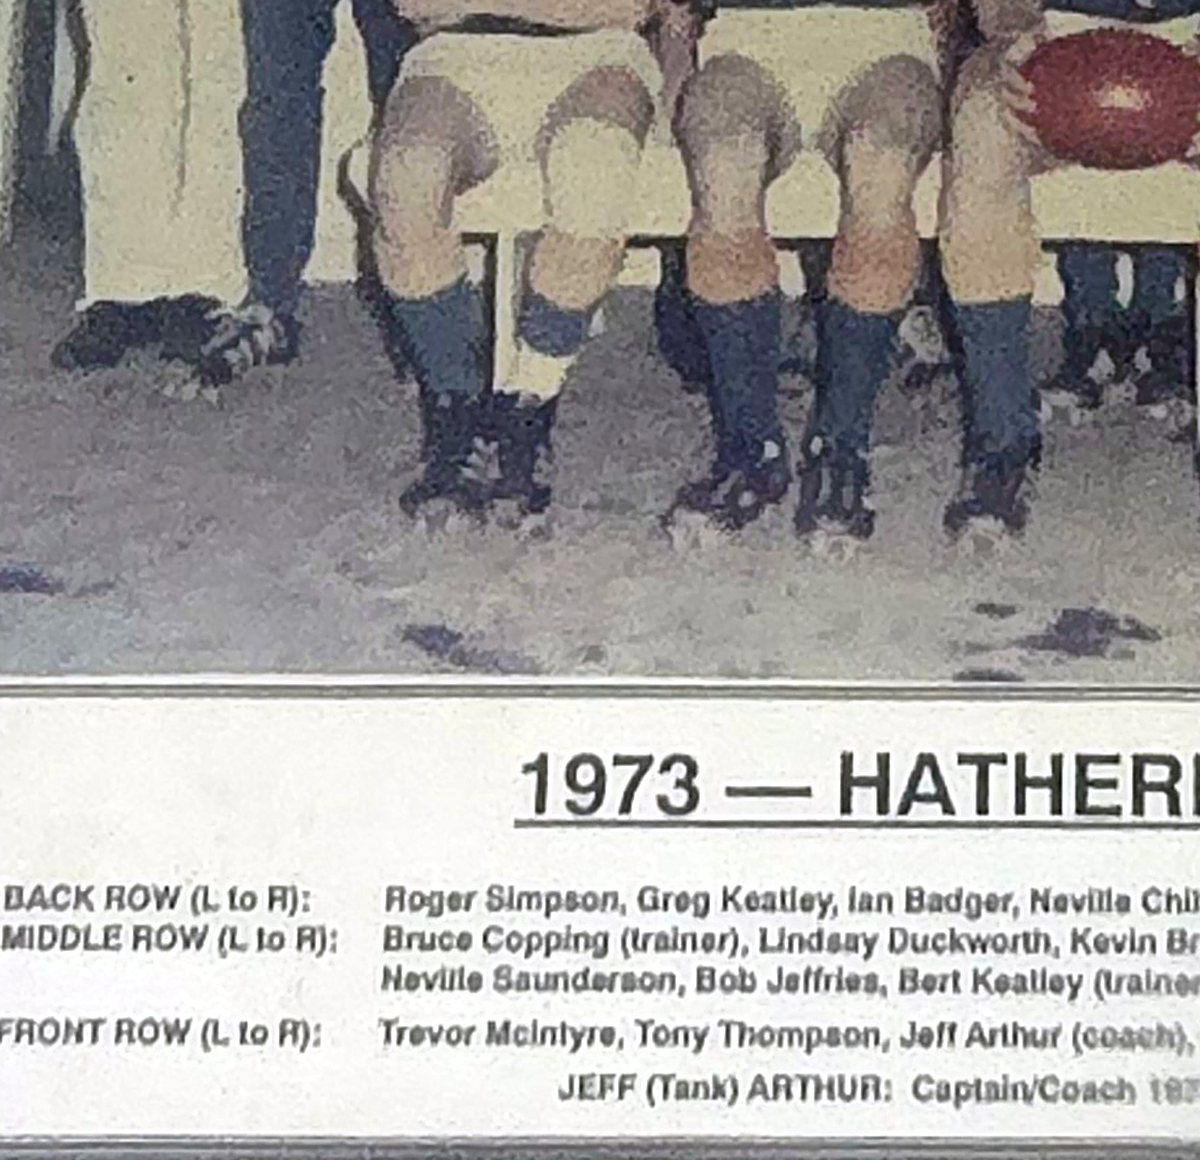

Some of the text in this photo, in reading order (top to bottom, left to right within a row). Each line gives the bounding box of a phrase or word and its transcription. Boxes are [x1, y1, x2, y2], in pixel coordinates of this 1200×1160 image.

[522, 753, 701, 818] 1973
[4, 884, 96, 913] BACK
[105, 884, 184, 913] ROW
[188, 885, 222, 917] (L
[228, 886, 258, 913] to
[269, 885, 312, 917] R):
[386, 886, 479, 919] Roger
[486, 885, 628, 921] Simpson,
[638, 886, 711, 921] Greg
[722, 886, 839, 922] Keatley,
[849, 886, 895, 917] Ian
[905, 887, 1021, 923] Badger,
[1031, 887, 1132, 918] Neville
[1, 924, 123, 953] MIDDLE
[133, 925, 210, 954] ROW
[219, 925, 250, 956] (L
[257, 927, 287, 954] to
[296, 925, 339, 956] R):
[384, 925, 474, 954] Bruce
[483, 925, 611, 961] Copping
[622, 926, 750, 962] (trainer),
[760, 927, 881, 963] Lindsay
[889, 928, 1061, 961] Duckworth,
[1071, 927, 1158, 958] Kevin
[382, 967, 484, 994] Neville
[494, 967, 687, 999] Saunderson,
[696, 966, 758, 996] Bob
[767, 966, 889, 1000] Jeffries,
[899, 967, 962, 997] Bert
[972, 968, 1084, 1002] Keatley
[0, 1018, 108, 1048] FRONT
[115, 1017, 193, 1048] ROW
[202, 1019, 231, 1052] (L
[240, 1022, 270, 1047] to
[280, 1019, 322, 1051] R):
[378, 1018, 478, 1051] Trevor
[486, 1020, 625, 1055] McIntyre,
[635, 1019, 711, 1056] Tony
[718, 1020, 891, 1057] Thompson,
[900, 1022, 957, 1051] Jeff
[965, 1022, 1063, 1052] Arthur
[1073, 1022, 1197, 1059] (coach),
[559, 1073, 638, 1103] JEFF
[647, 1074, 740, 1109] (Tank)
[747, 1074, 894, 1105] ARTHUR:
[912, 1074, 1138, 1112] Captain/Coach
